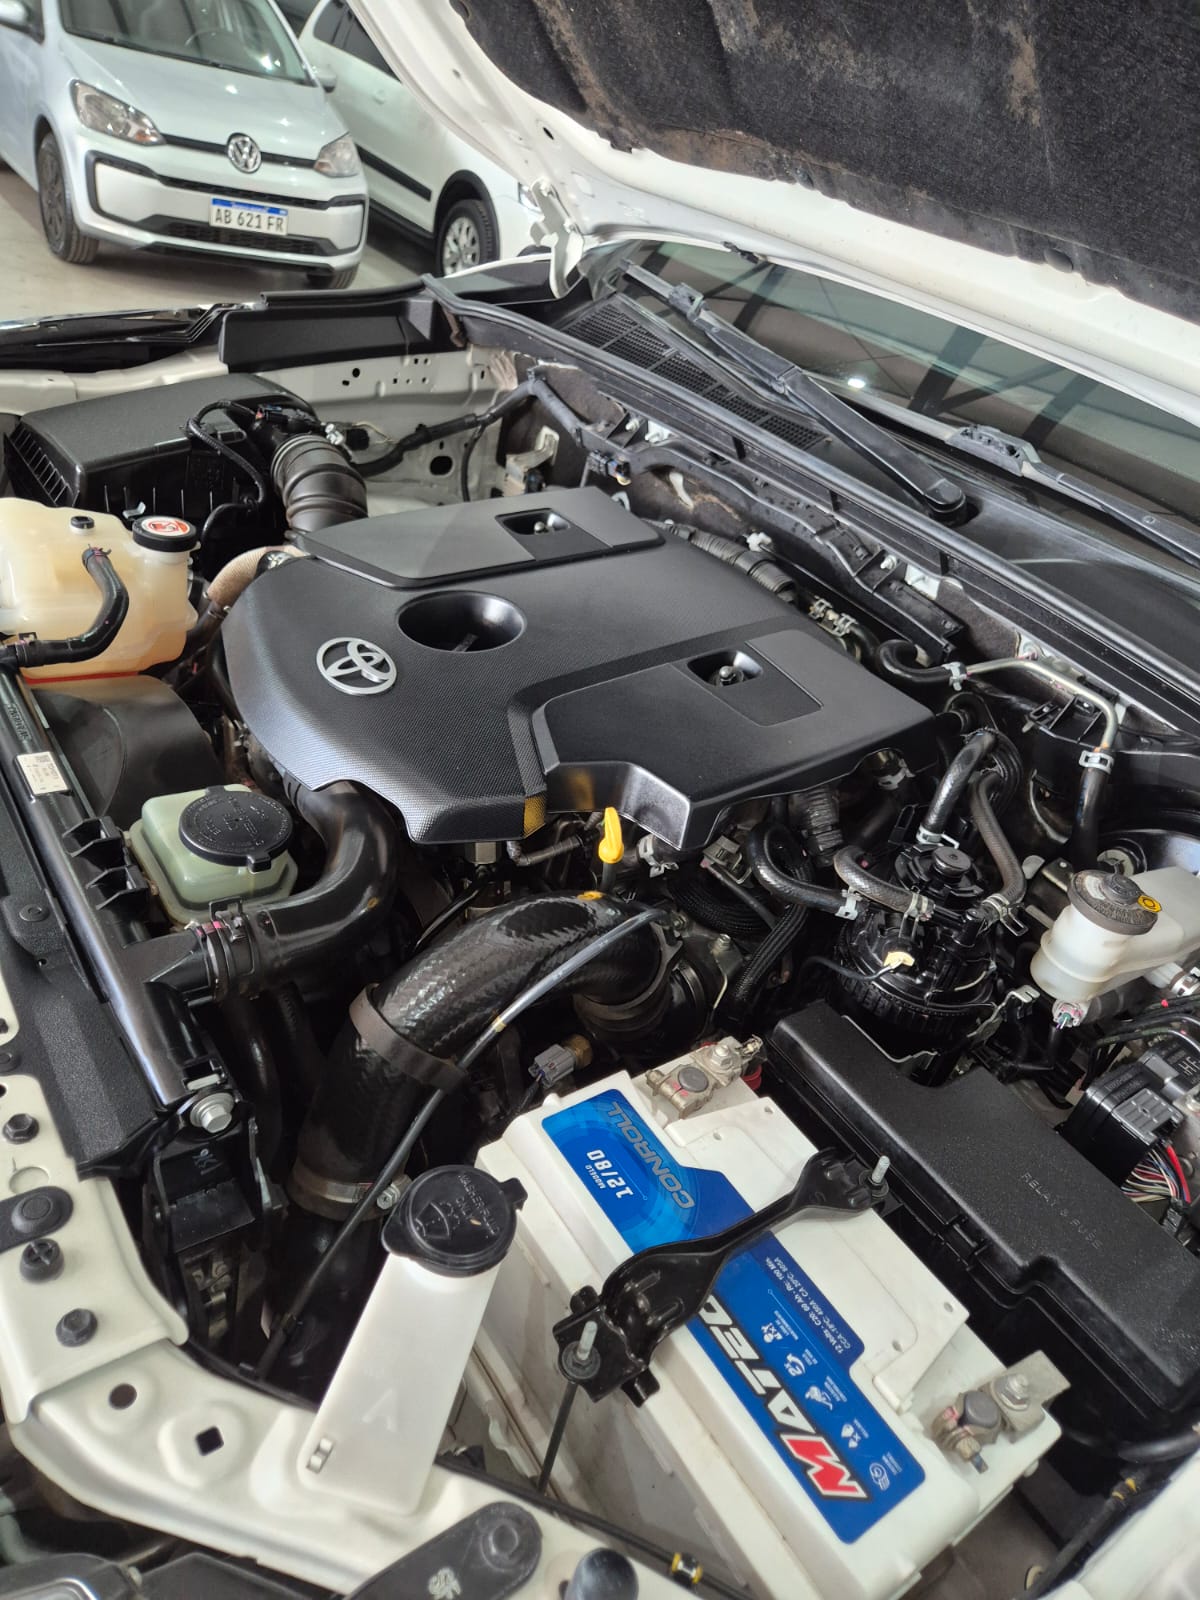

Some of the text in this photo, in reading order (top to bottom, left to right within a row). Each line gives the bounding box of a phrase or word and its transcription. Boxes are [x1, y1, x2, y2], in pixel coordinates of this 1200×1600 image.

[215, 208, 284, 232] AB 621 FR
[608, 1101, 695, 1209] CONROLL
[585, 1164, 606, 1189] MODELO
[587, 1149, 634, 1199] 12/80
